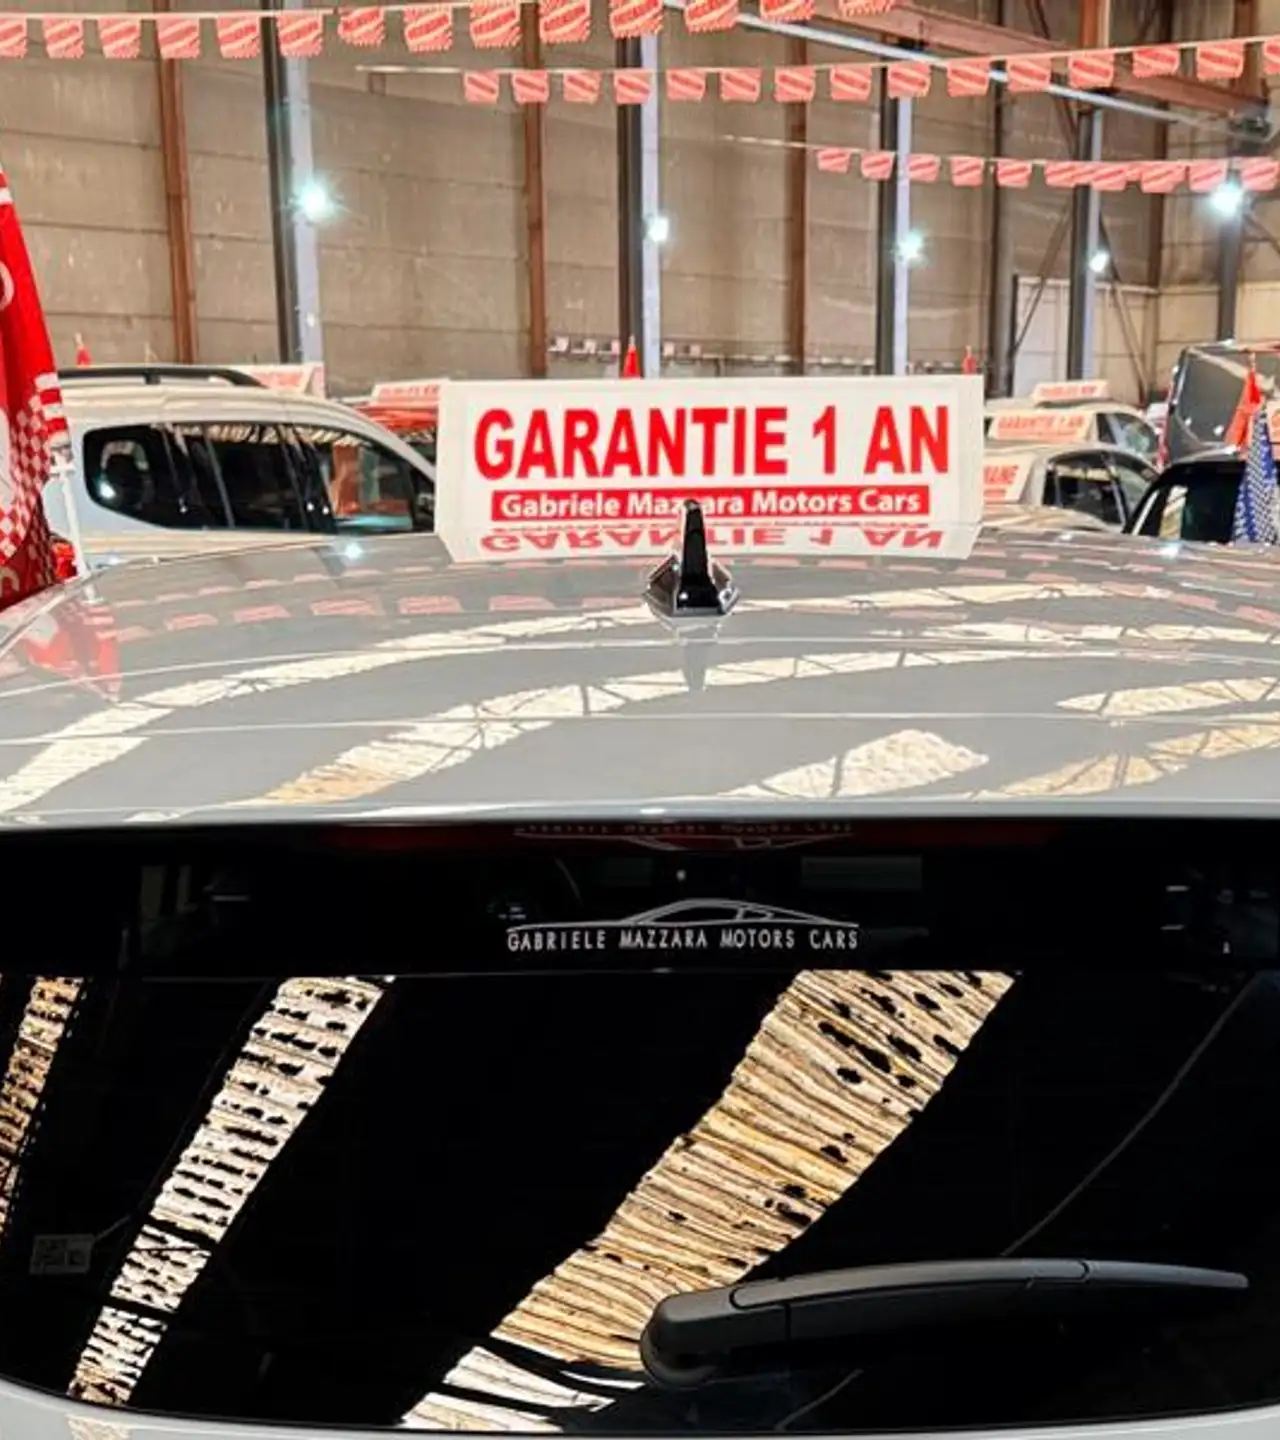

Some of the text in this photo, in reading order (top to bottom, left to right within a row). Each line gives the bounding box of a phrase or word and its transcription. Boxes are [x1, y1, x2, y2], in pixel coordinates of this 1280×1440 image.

[474, 405, 949, 480] GARANTIE 1 AN
[501, 488, 920, 518] Gabriele Mazara Motors Cars
[507, 929, 859, 951] GABRIELE MAZZARA MOTORS CARS
